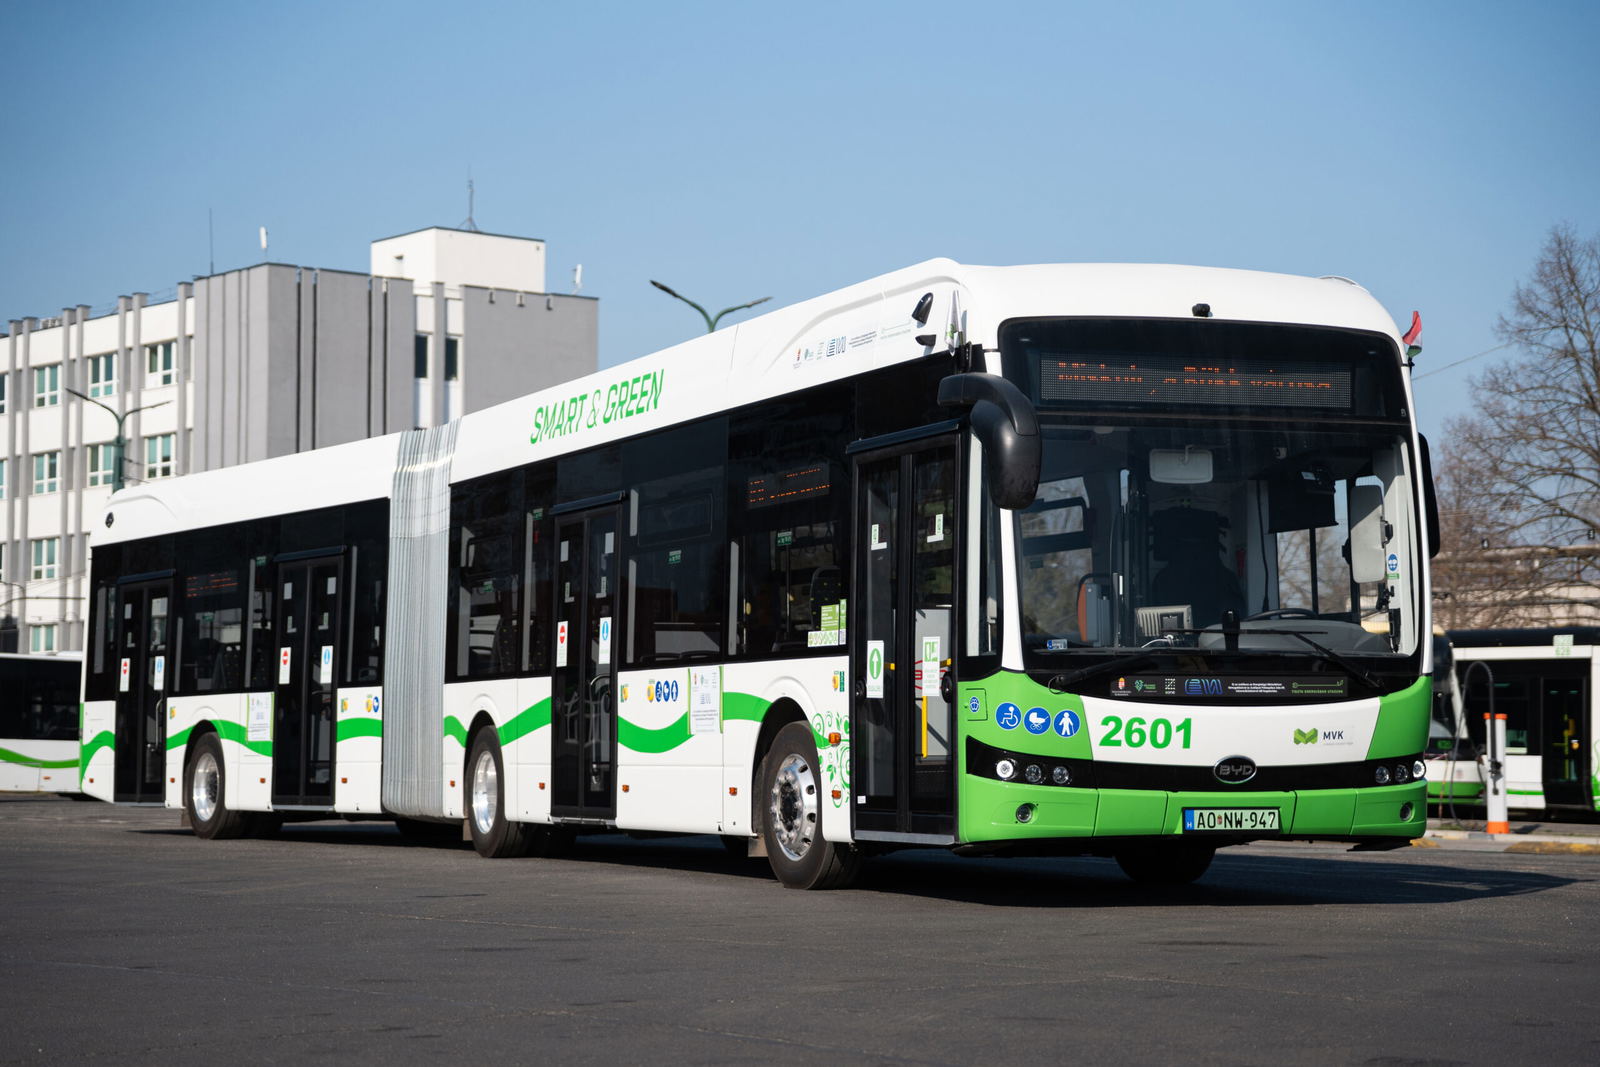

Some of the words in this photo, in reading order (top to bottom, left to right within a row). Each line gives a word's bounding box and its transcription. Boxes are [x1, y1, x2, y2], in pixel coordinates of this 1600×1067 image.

[530, 394, 587, 444] SMART
[586, 389, 601, 429] &
[603, 368, 664, 424] GREEN
[1099, 715, 1193, 750] 2601
[1322, 730, 1344, 741] MVK
[1219, 764, 1253, 776] BYD
